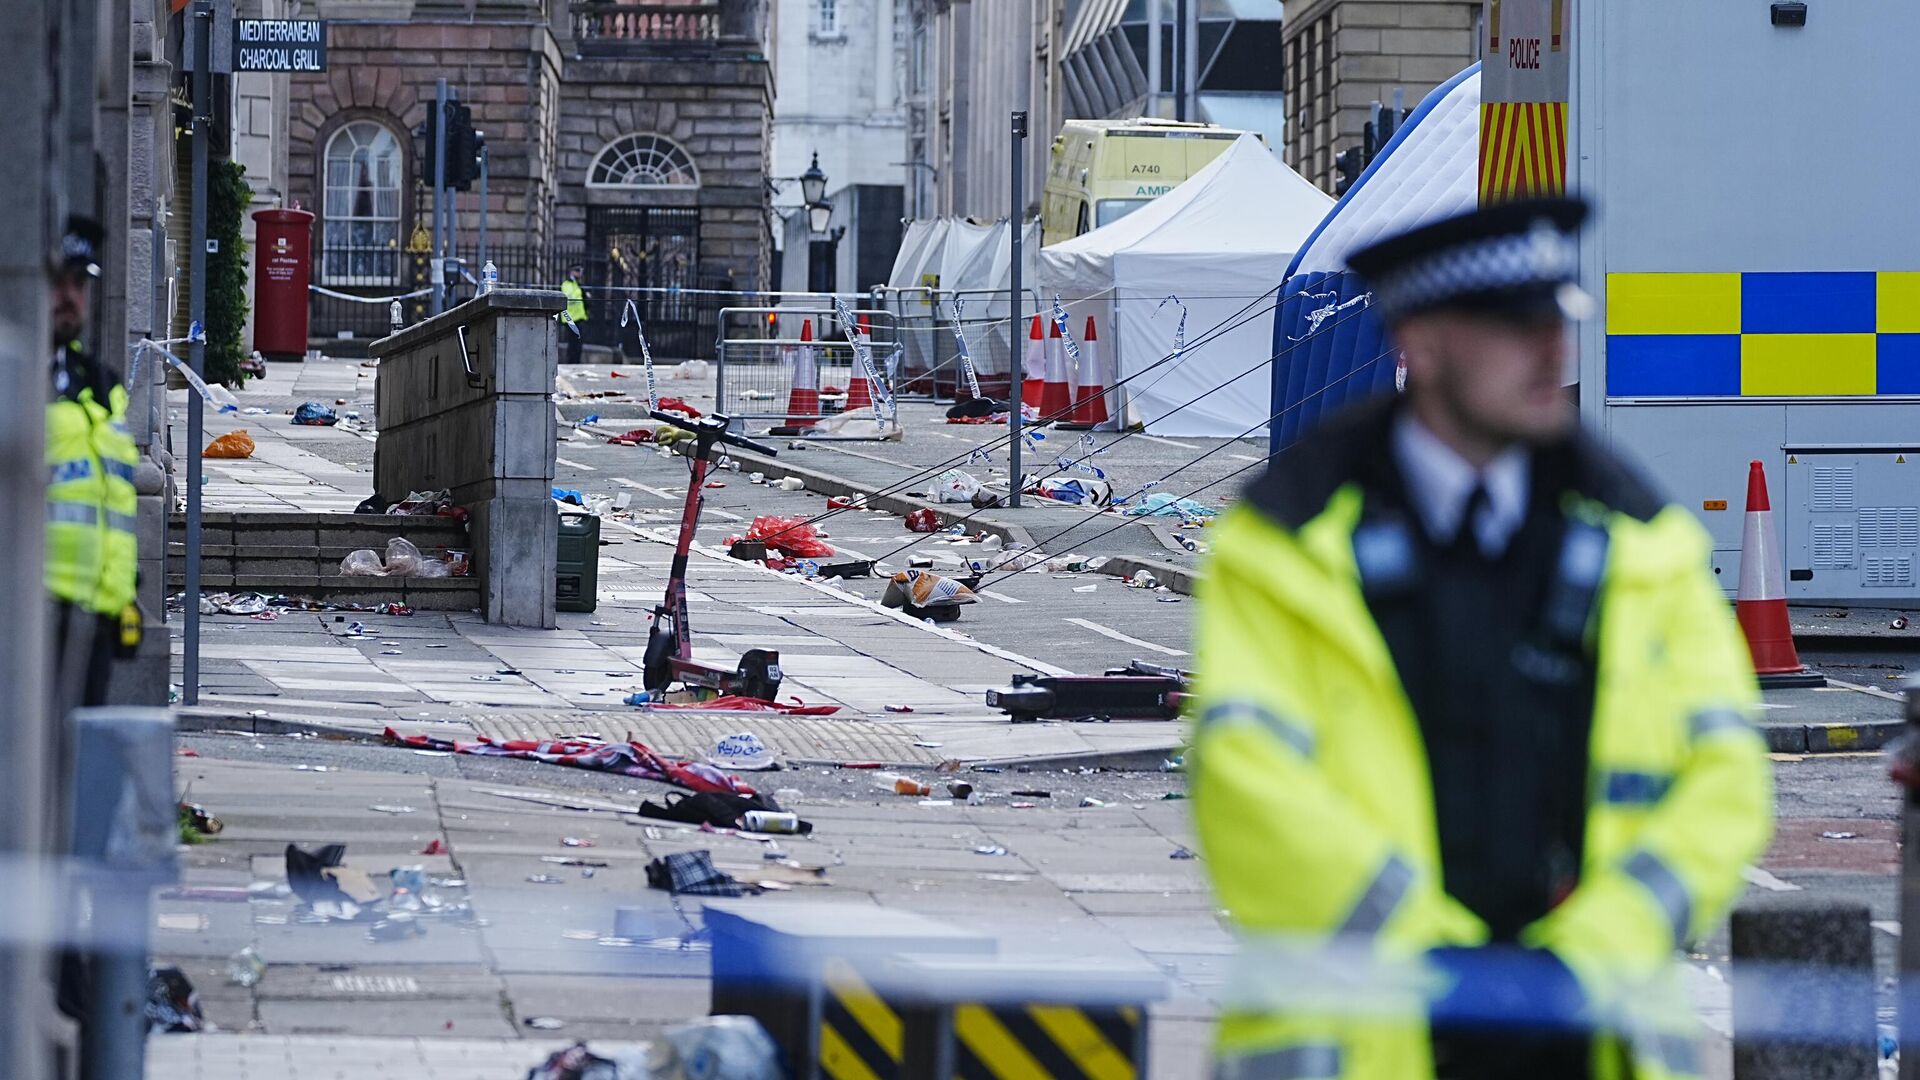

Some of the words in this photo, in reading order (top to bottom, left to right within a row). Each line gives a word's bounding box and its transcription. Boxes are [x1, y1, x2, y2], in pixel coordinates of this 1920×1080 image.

[239, 19, 320, 42] MEDITERRANEAN
[239, 48, 291, 70] CHARCOAL
[293, 49, 320, 70] GRILL
[1509, 38, 1541, 70] POLICE
[1131, 164, 1160, 174] A740
